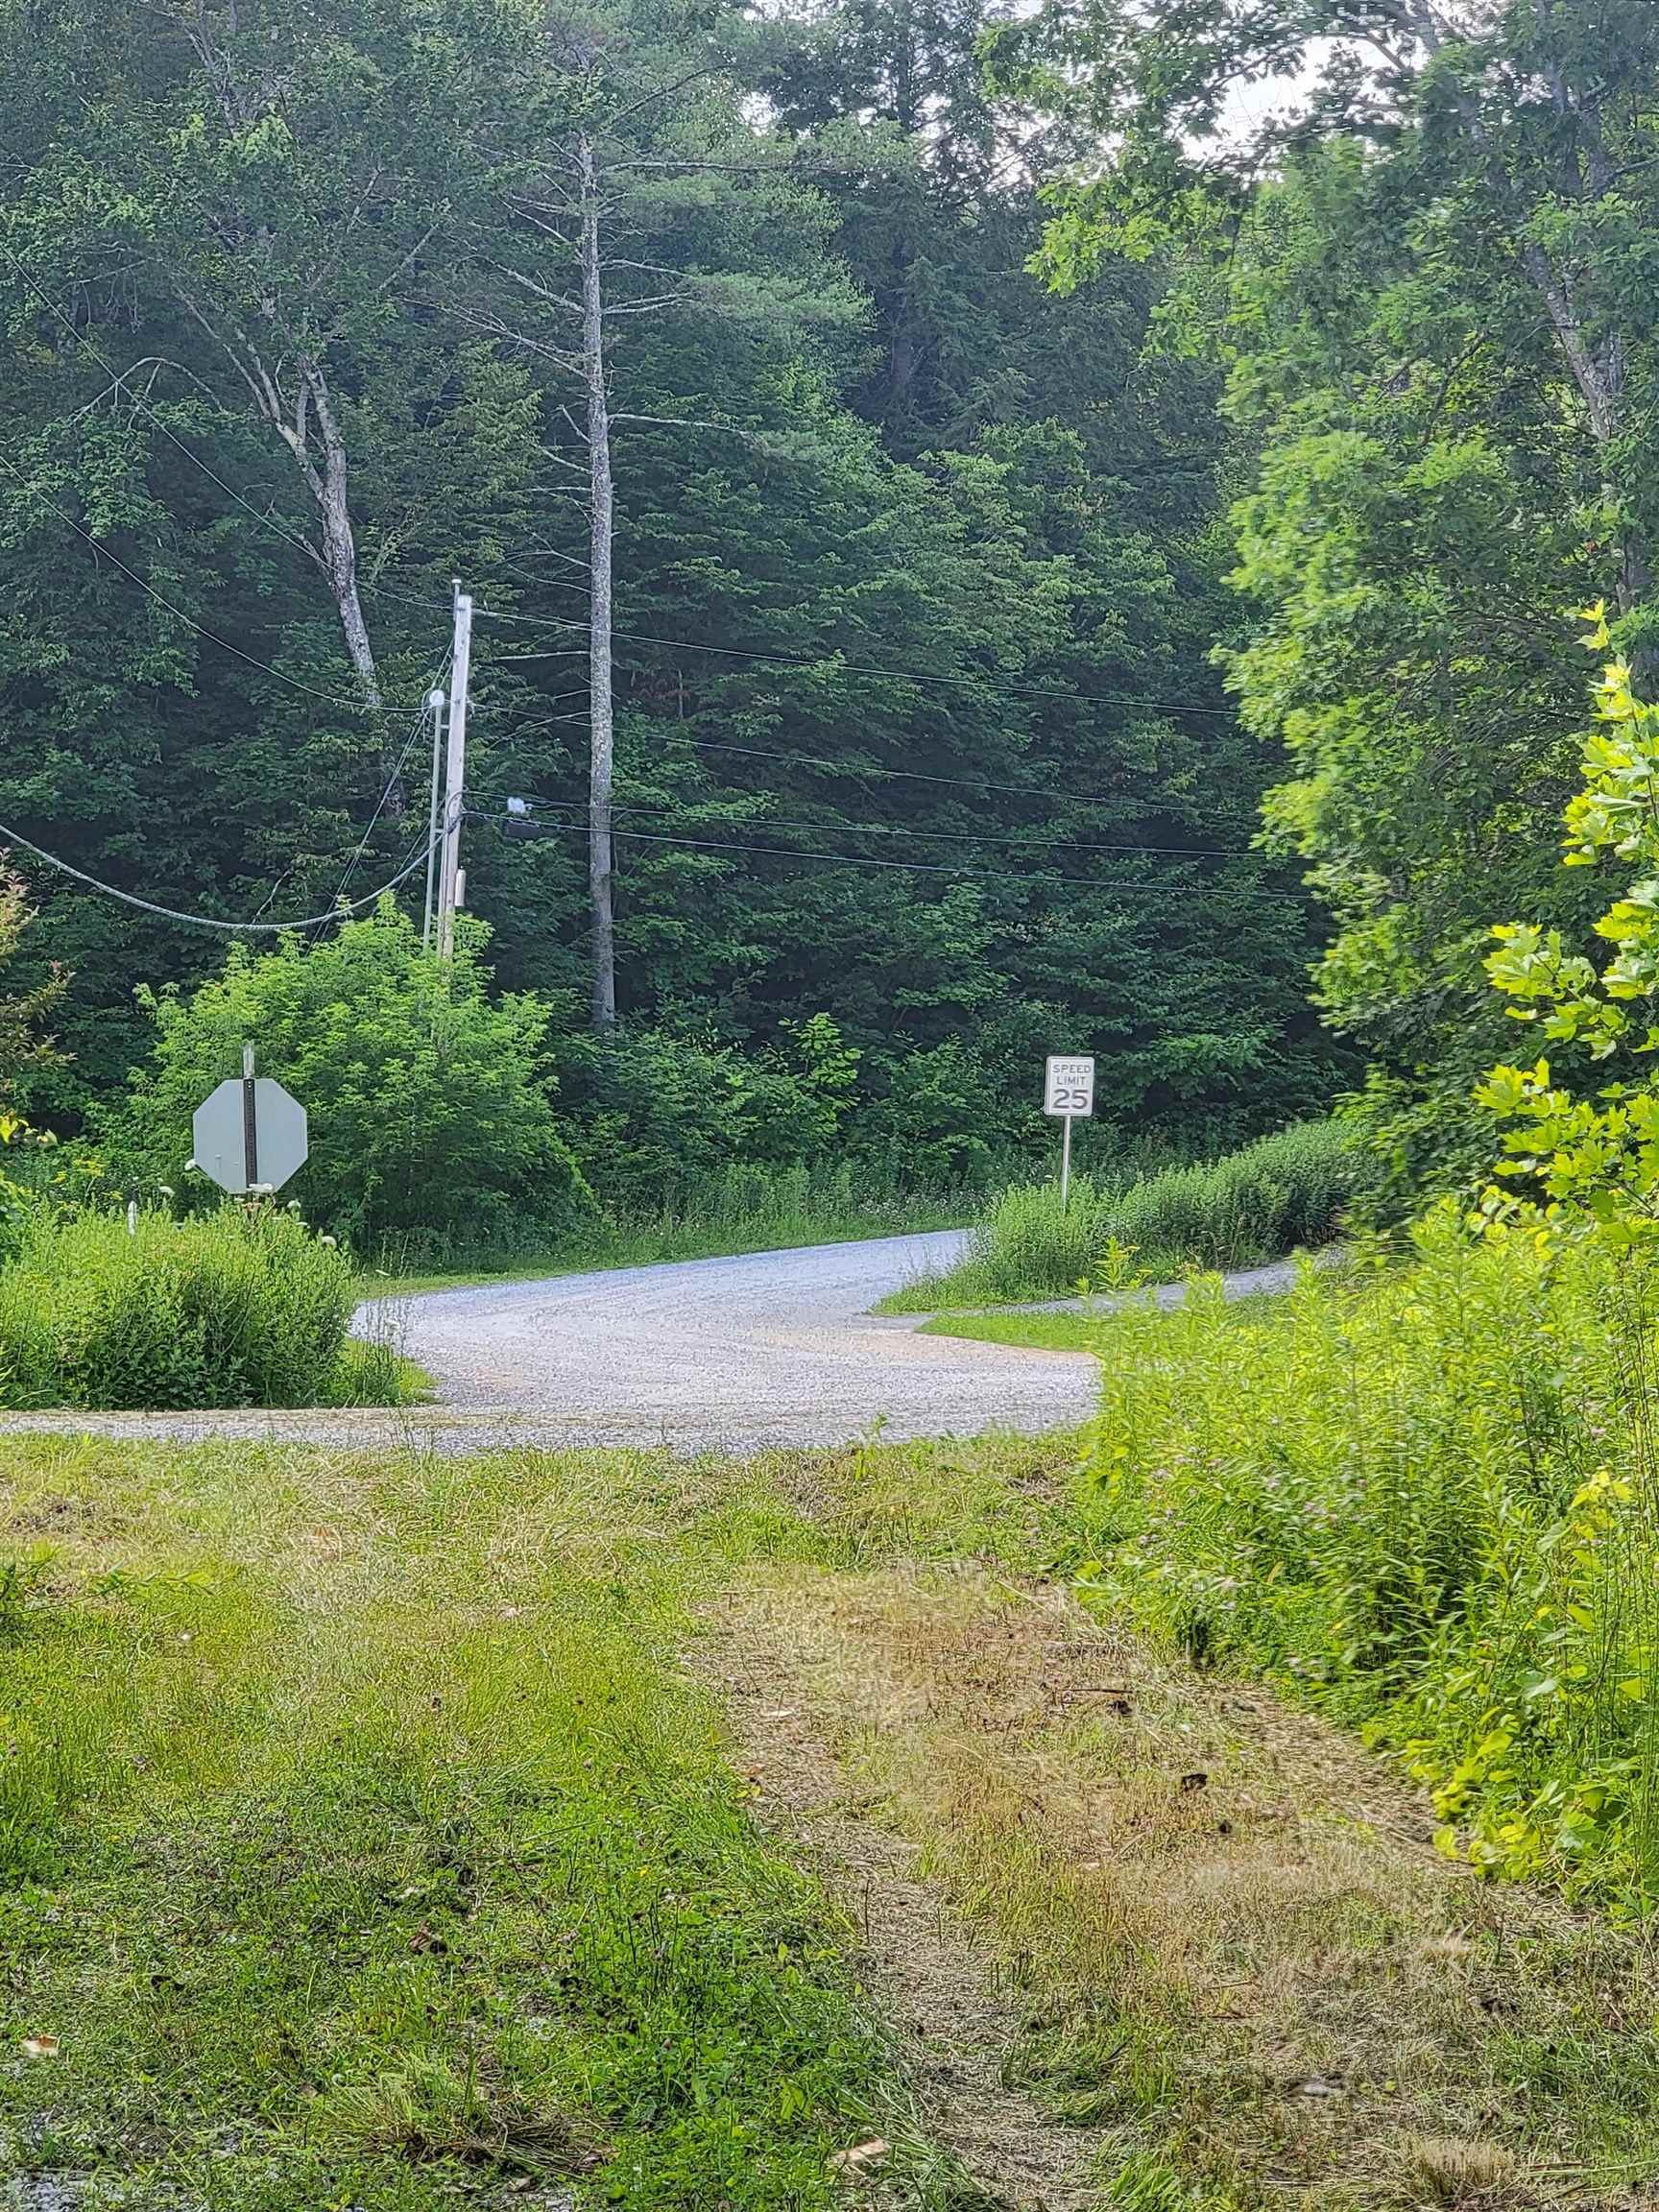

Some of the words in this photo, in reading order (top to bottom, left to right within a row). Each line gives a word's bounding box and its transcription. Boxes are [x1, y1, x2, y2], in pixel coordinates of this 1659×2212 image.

[1052, 1064, 1092, 1073] SPEED
[1057, 1076, 1086, 1085] LIMIT
[1052, 1089, 1089, 1109] 25
